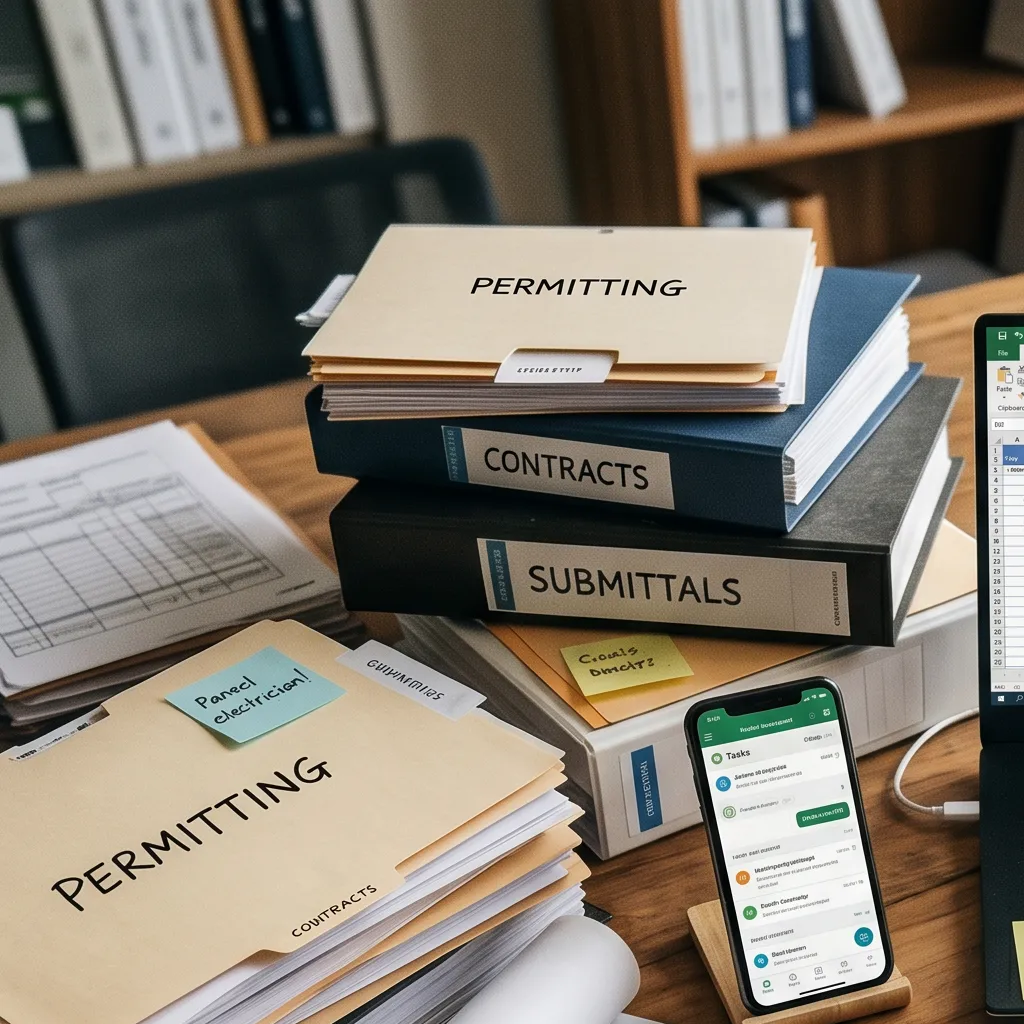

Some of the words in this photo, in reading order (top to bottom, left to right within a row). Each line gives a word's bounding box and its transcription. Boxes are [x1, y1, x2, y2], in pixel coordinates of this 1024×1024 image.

[470, 277, 688, 297] PERMITTING
[484, 447, 649, 490] CONTRACTS
[528, 565, 742, 606] SUBMITTALS
[213, 668, 313, 725] electrician!
[726, 749, 750, 761] Tasks
[51, 756, 334, 911] PERMITTING
